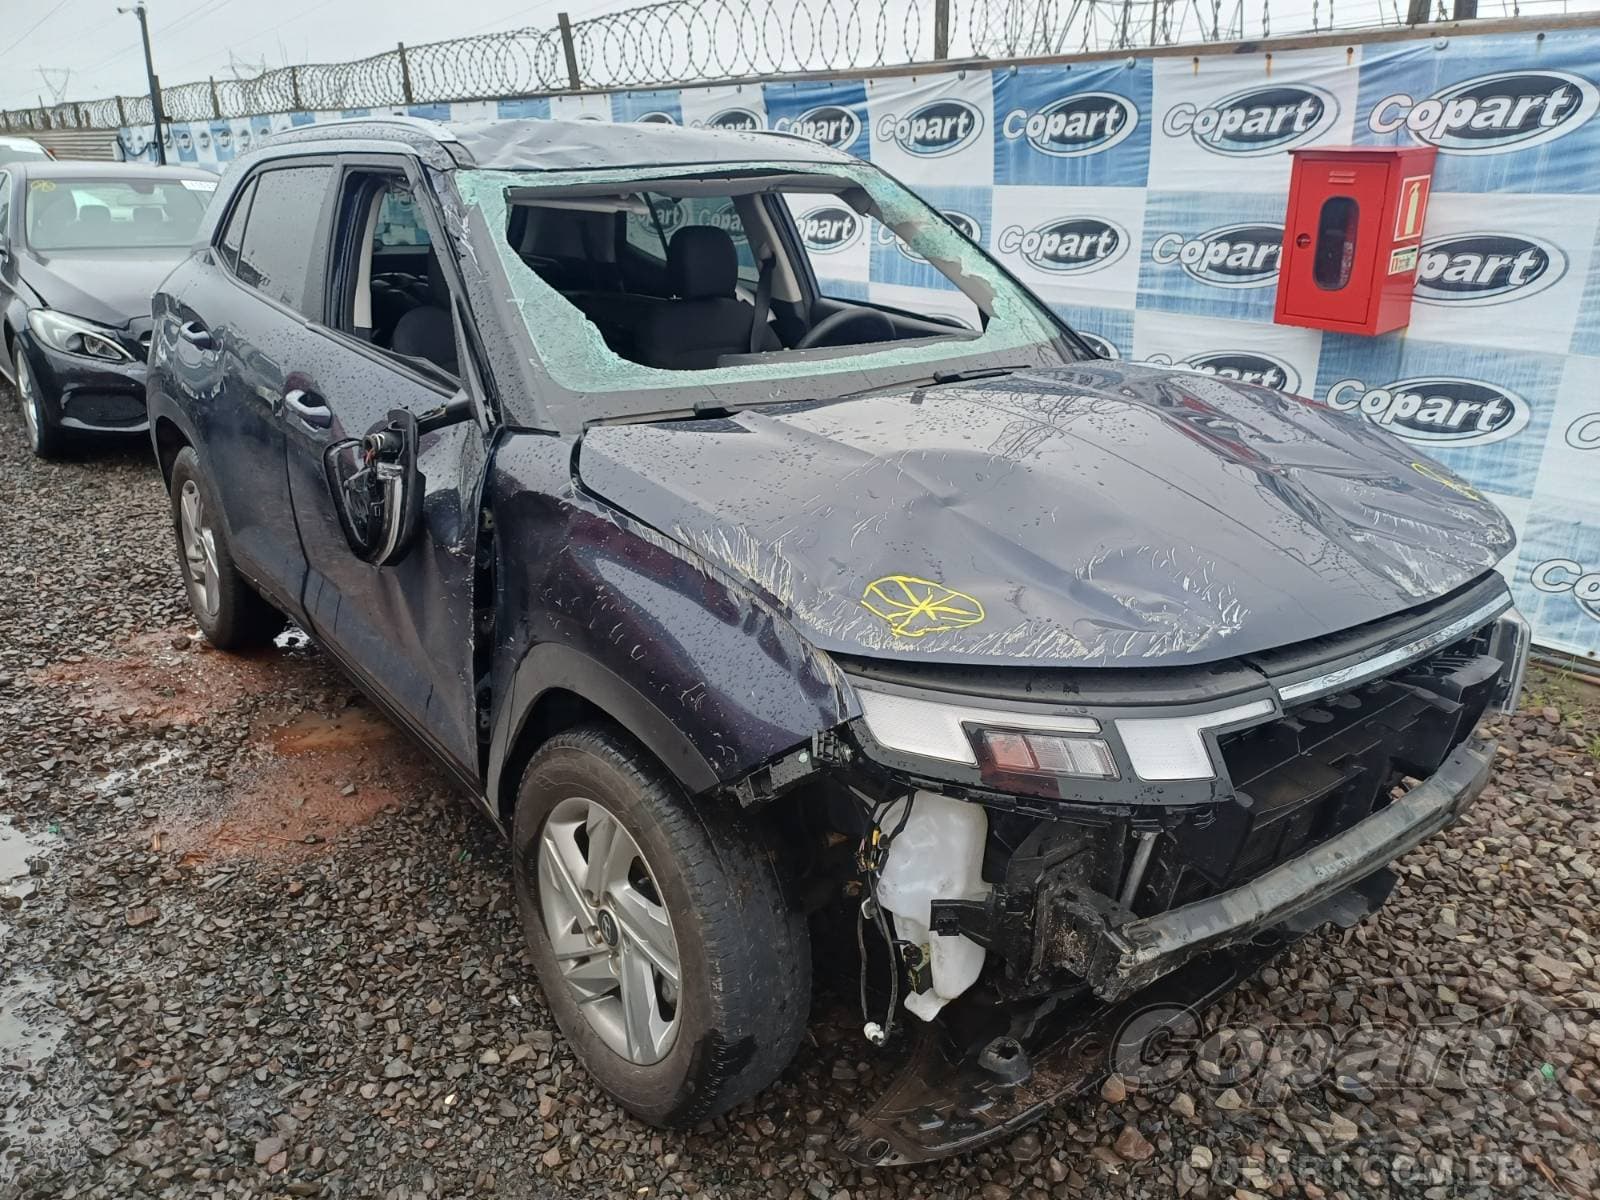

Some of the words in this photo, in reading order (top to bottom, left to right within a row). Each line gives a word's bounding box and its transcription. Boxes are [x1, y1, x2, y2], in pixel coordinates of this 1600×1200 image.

[876, 110, 969, 146] Copart
[1002, 102, 1120, 144] Copart
[1163, 93, 1318, 142] Copart
[1368, 82, 1575, 140] Copart
[998, 224, 1112, 261] Copart
[1414, 242, 1541, 288] part
[1326, 379, 1509, 433] Copart
